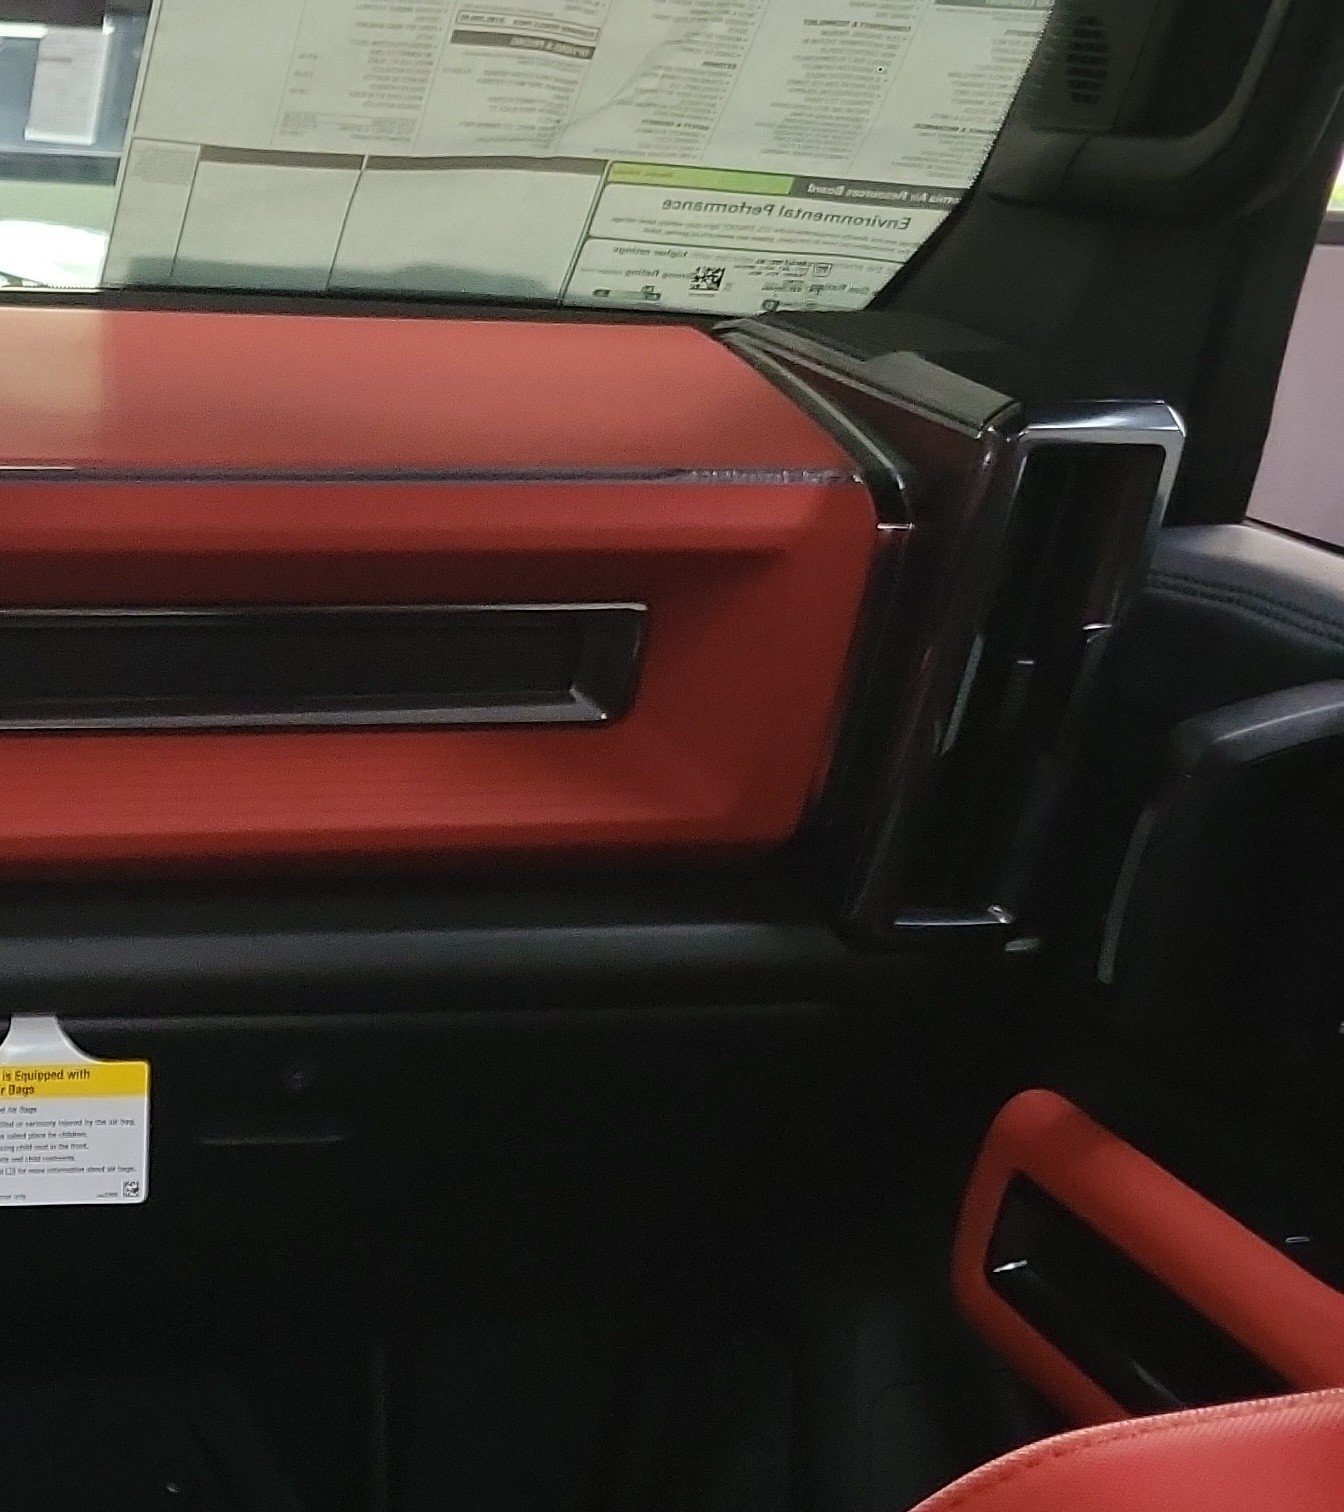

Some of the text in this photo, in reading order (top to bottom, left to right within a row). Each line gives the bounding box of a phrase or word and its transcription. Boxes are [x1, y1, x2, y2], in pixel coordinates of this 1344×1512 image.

[2, 1071, 11, 1081] is
[15, 1070, 64, 1082] Equipped
[68, 1069, 90, 1080] with
[9, 1084, 35, 1096] Bags
